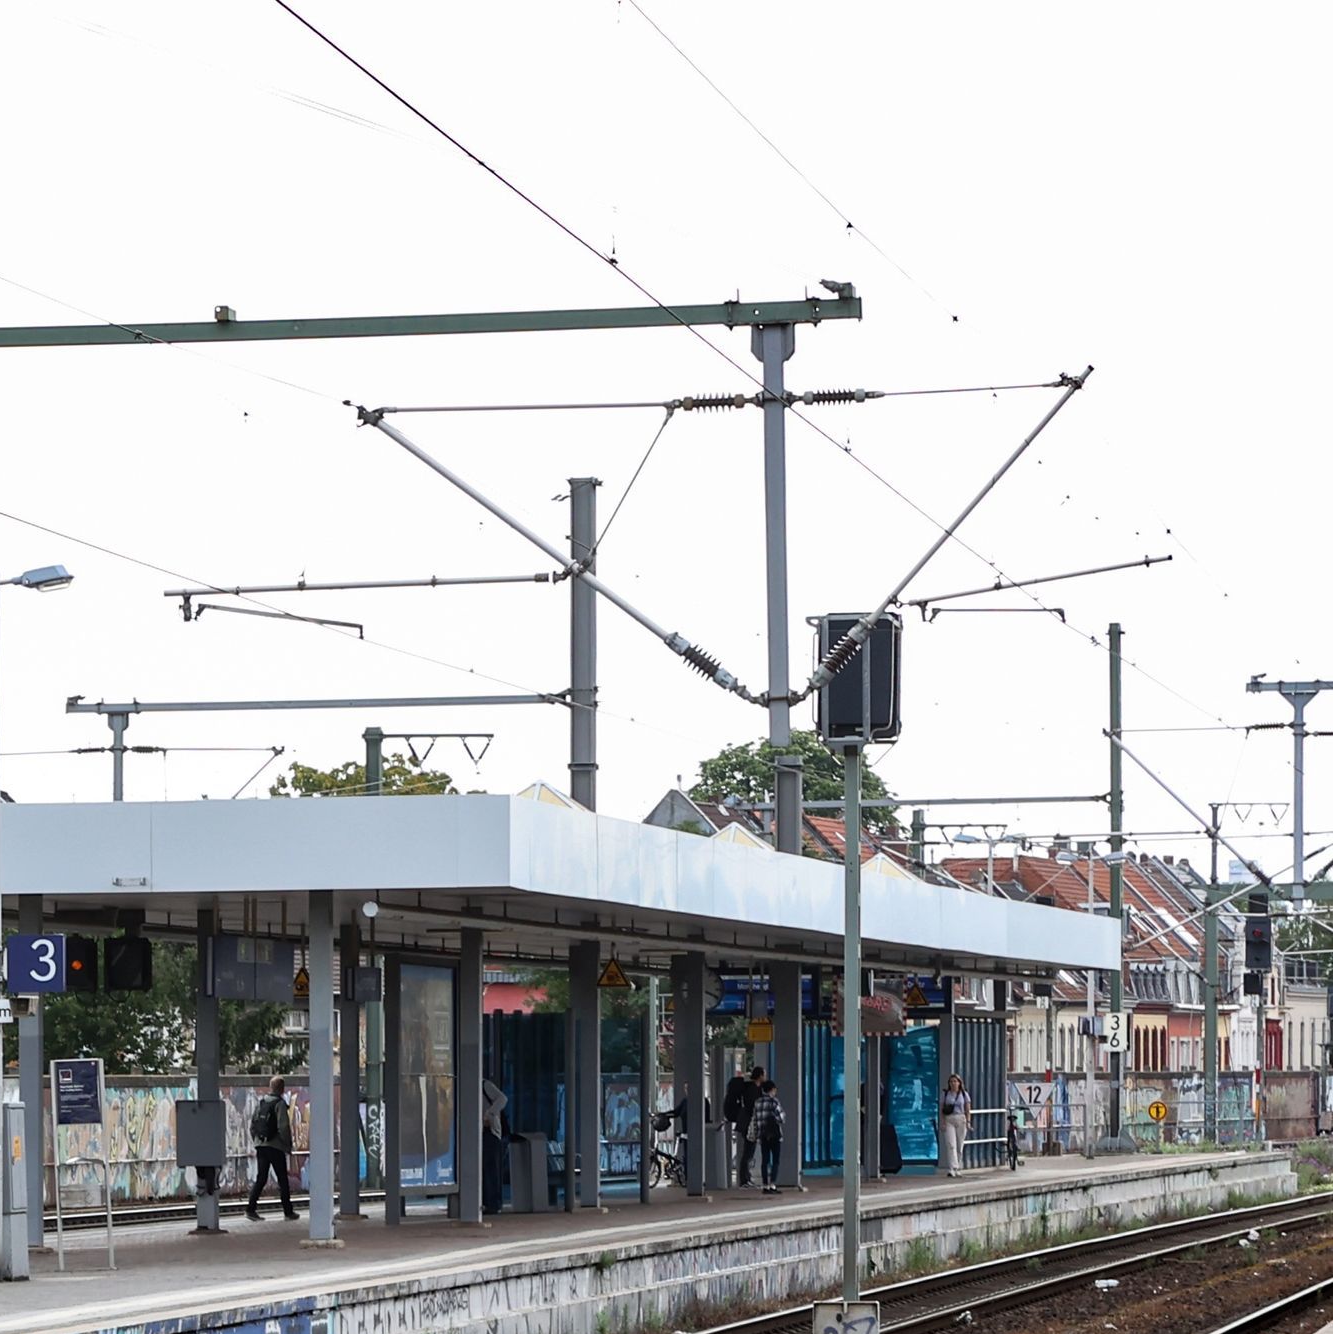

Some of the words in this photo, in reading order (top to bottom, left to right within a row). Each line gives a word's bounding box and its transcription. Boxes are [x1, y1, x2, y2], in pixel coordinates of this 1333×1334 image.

[29, 938, 57, 982] 3
[0, 1007, 12, 1017] m
[1110, 1015, 1120, 1030] 3
[1110, 1032, 1120, 1048] 6
[1026, 1085, 1041, 1104] 12
